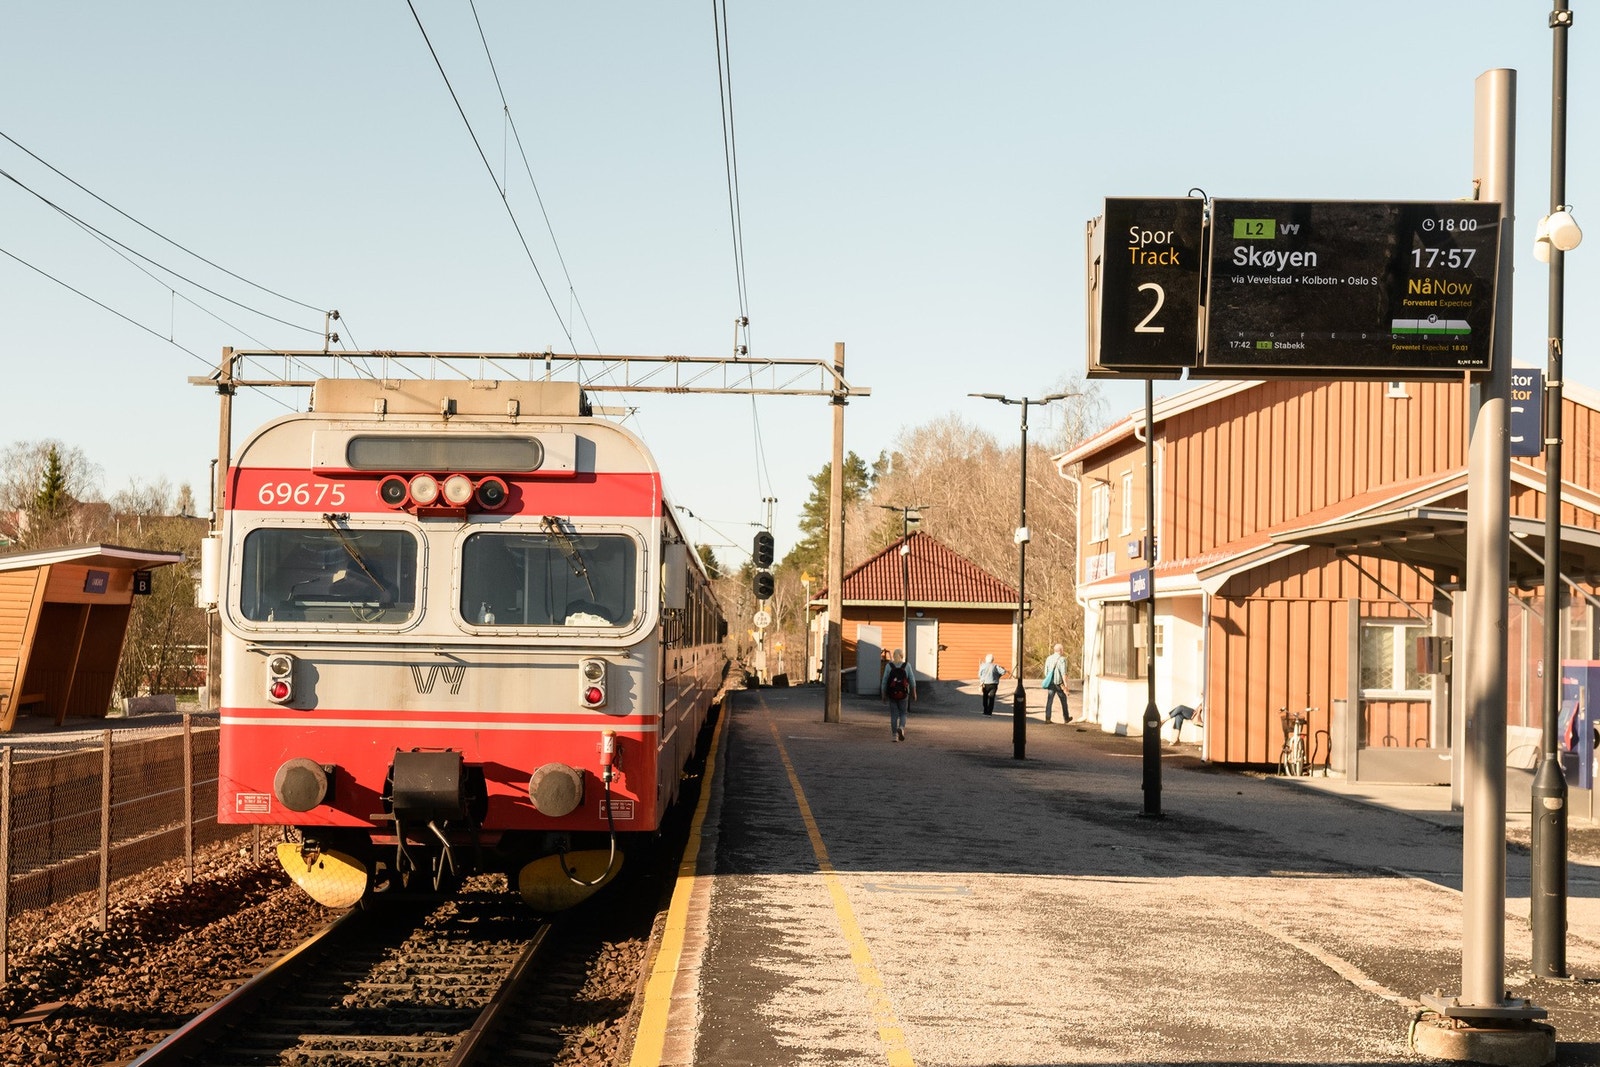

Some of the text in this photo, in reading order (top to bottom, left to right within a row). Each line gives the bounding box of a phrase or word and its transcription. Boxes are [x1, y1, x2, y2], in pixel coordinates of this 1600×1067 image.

[1129, 226, 1174, 248] Spor
[1245, 222, 1264, 236] L2
[1127, 246, 1181, 265] Track
[1232, 245, 1317, 272] Skøyen
[1411, 248, 1477, 269] 17:57
[1231, 275, 1378, 286] via Vevelstad Kolbotn Oslo S
[1408, 277, 1473, 296] Nå Now
[1134, 282, 1165, 333] 2
[1402, 298, 1472, 308] Forventet Expected
[1230, 341, 1251, 349] 17:42
[1274, 341, 1305, 349] Stabekk
[1511, 374, 1533, 387] tor
[1511, 388, 1533, 401] tor
[258, 482, 346, 506] 69675
[139, 581, 146, 591] B
